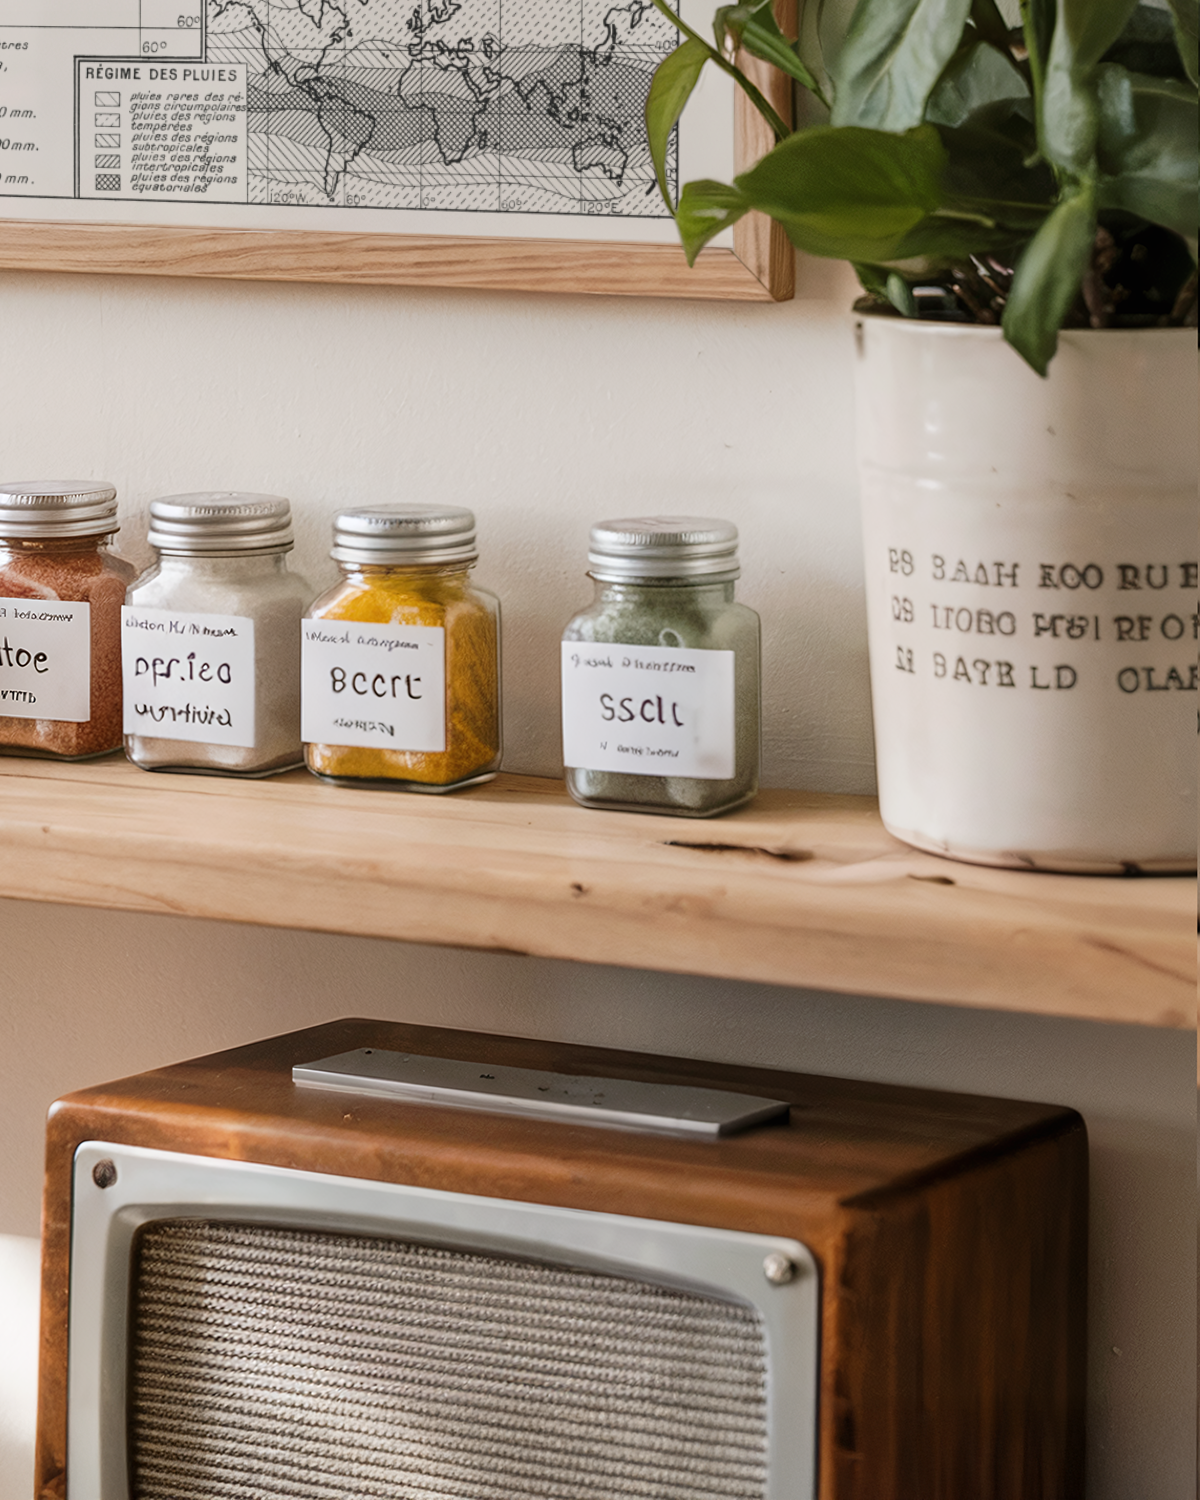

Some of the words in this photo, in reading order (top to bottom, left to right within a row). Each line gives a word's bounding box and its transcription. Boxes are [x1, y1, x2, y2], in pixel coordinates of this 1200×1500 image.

[86, 64, 141, 80] RÉGIME
[149, 68, 178, 81] DES
[183, 69, 238, 82] PLUIES
[130, 90, 162, 102] pluies
[166, 93, 199, 101] rares
[204, 92, 225, 102] des
[131, 111, 168, 123] pluies
[170, 111, 191, 121] des
[131, 132, 167, 143] pluies
[171, 133, 192, 142] des
